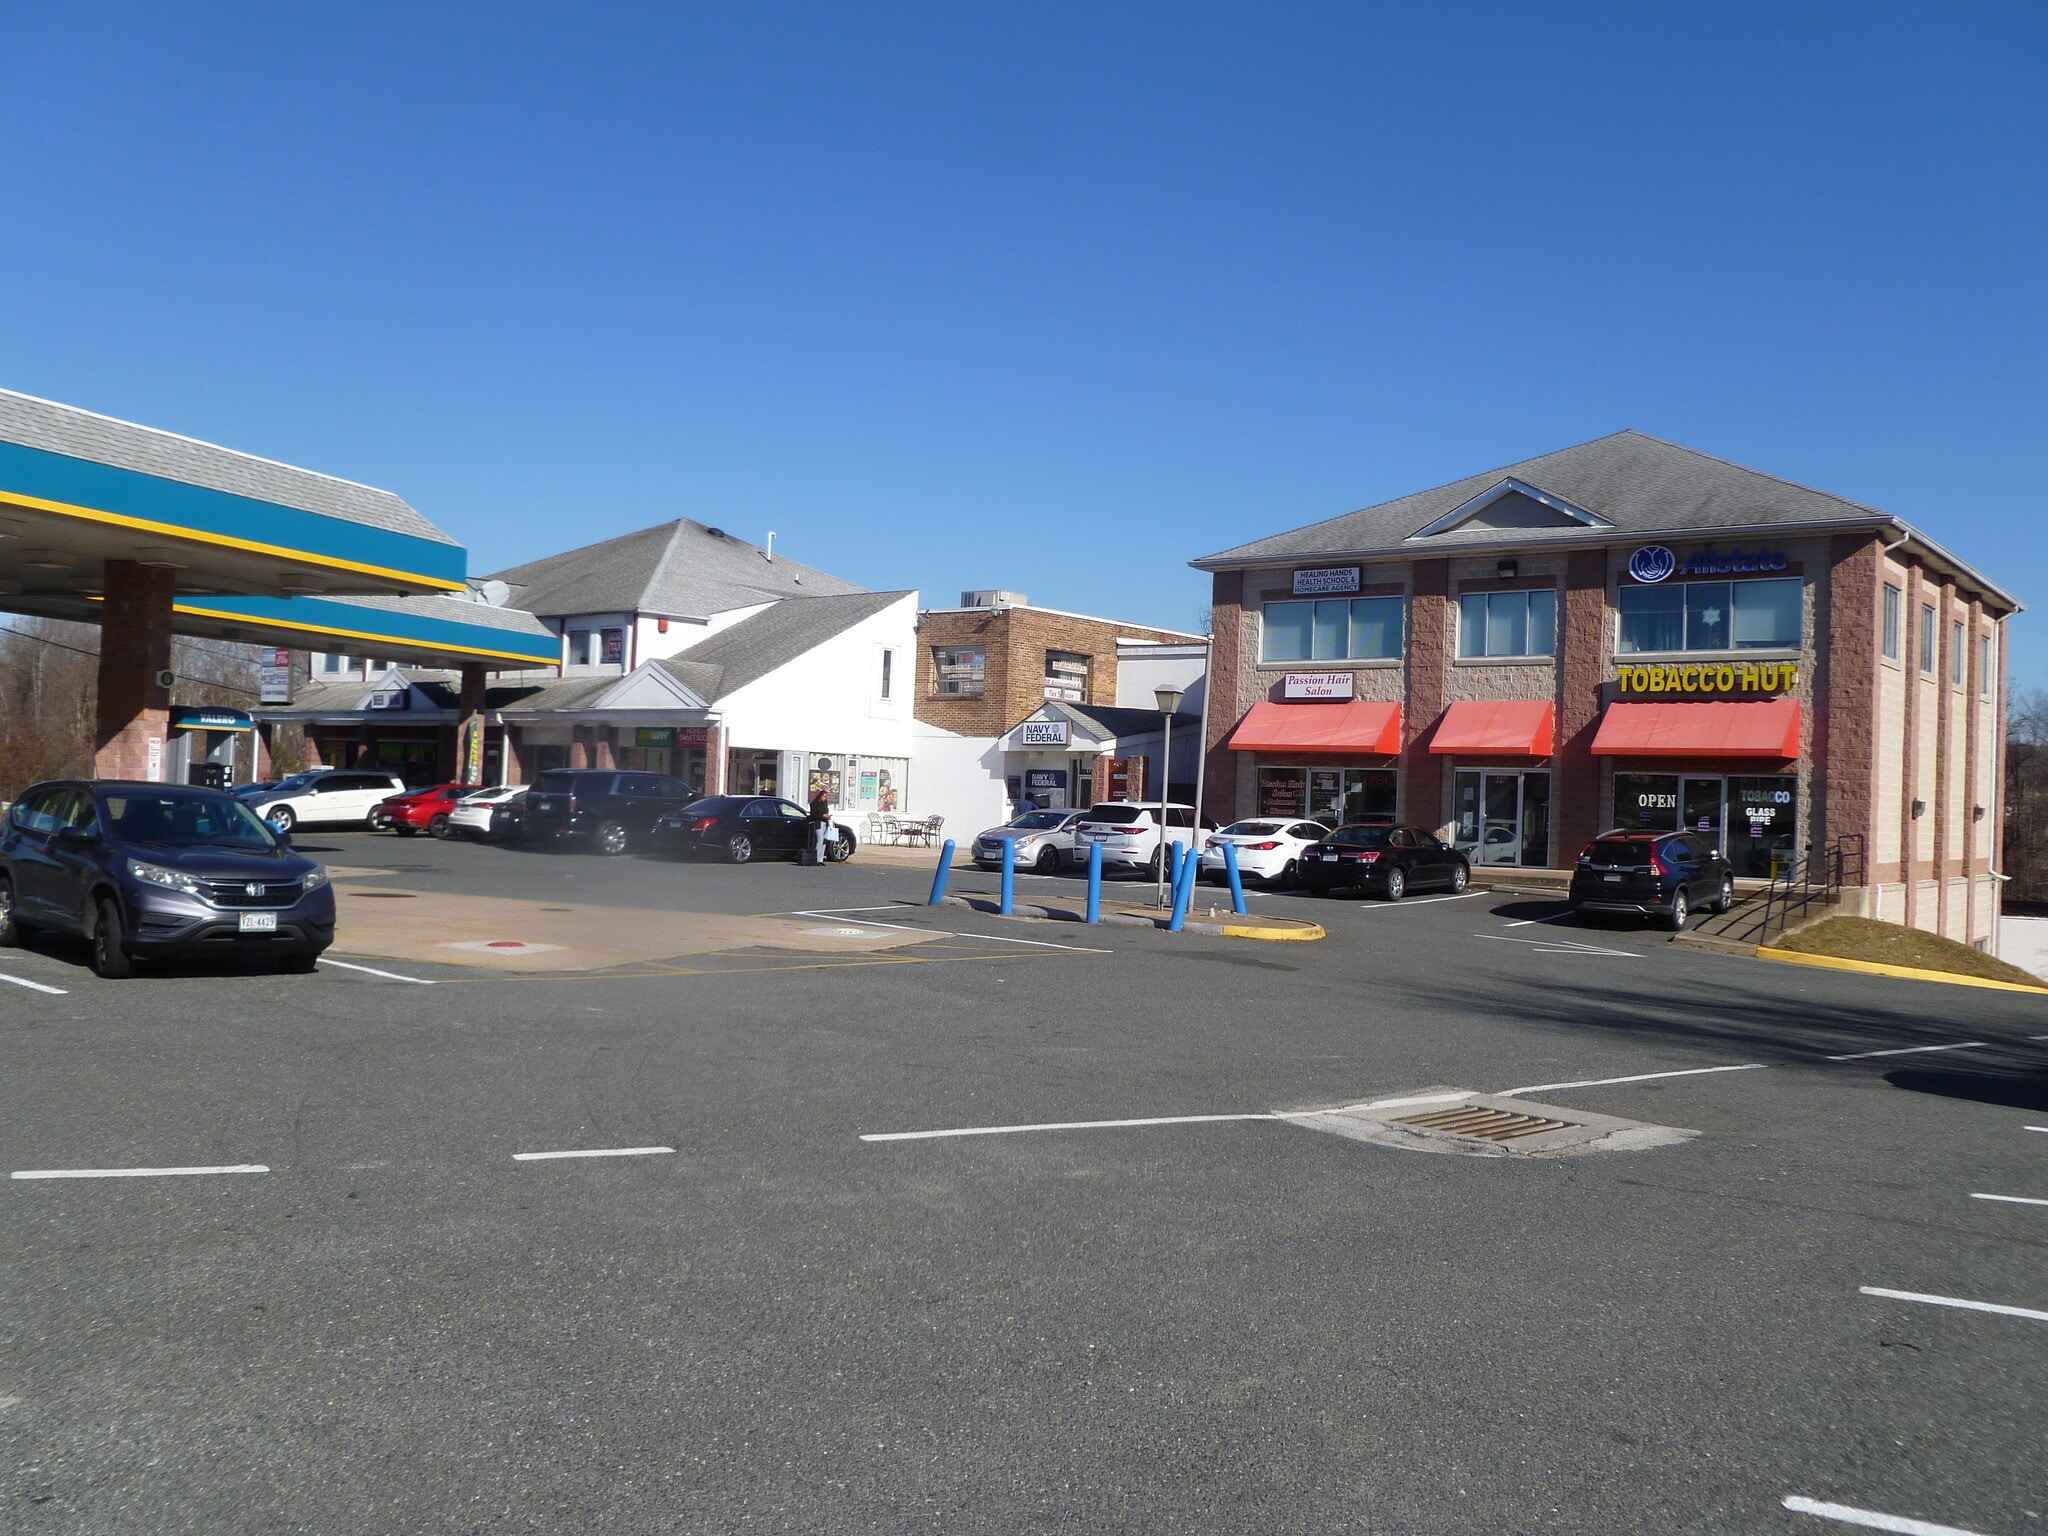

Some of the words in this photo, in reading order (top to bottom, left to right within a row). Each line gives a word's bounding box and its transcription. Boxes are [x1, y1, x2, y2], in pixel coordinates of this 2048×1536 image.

[1679, 548, 1787, 575] Allstate
[1300, 570, 1328, 578] HEALING
[1330, 569, 1353, 577] HANDS
[1297, 577, 1322, 586] HEALTH
[1322, 576, 1349, 585] SCHOOL
[1295, 585, 1330, 593] HOMECARE
[1331, 584, 1358, 592] AGENCY
[1288, 675, 1324, 685] Passion
[1327, 674, 1350, 684] Hair
[1617, 666, 1735, 693] TOBACCO
[1741, 665, 1797, 692] HUT
[1305, 686, 1332, 696] Salon
[200, 713, 236, 724] VALERO
[1026, 724, 1050, 734] NAVY
[1026, 733, 1064, 743] FEDERAL
[1031, 779, 1057, 787] FEDERAL
[1638, 794, 1677, 808] OPEN
[1740, 789, 1790, 803] TOBACCO
[1745, 807, 1776, 817] GLASS
[1749, 816, 1771, 826] PIPE
